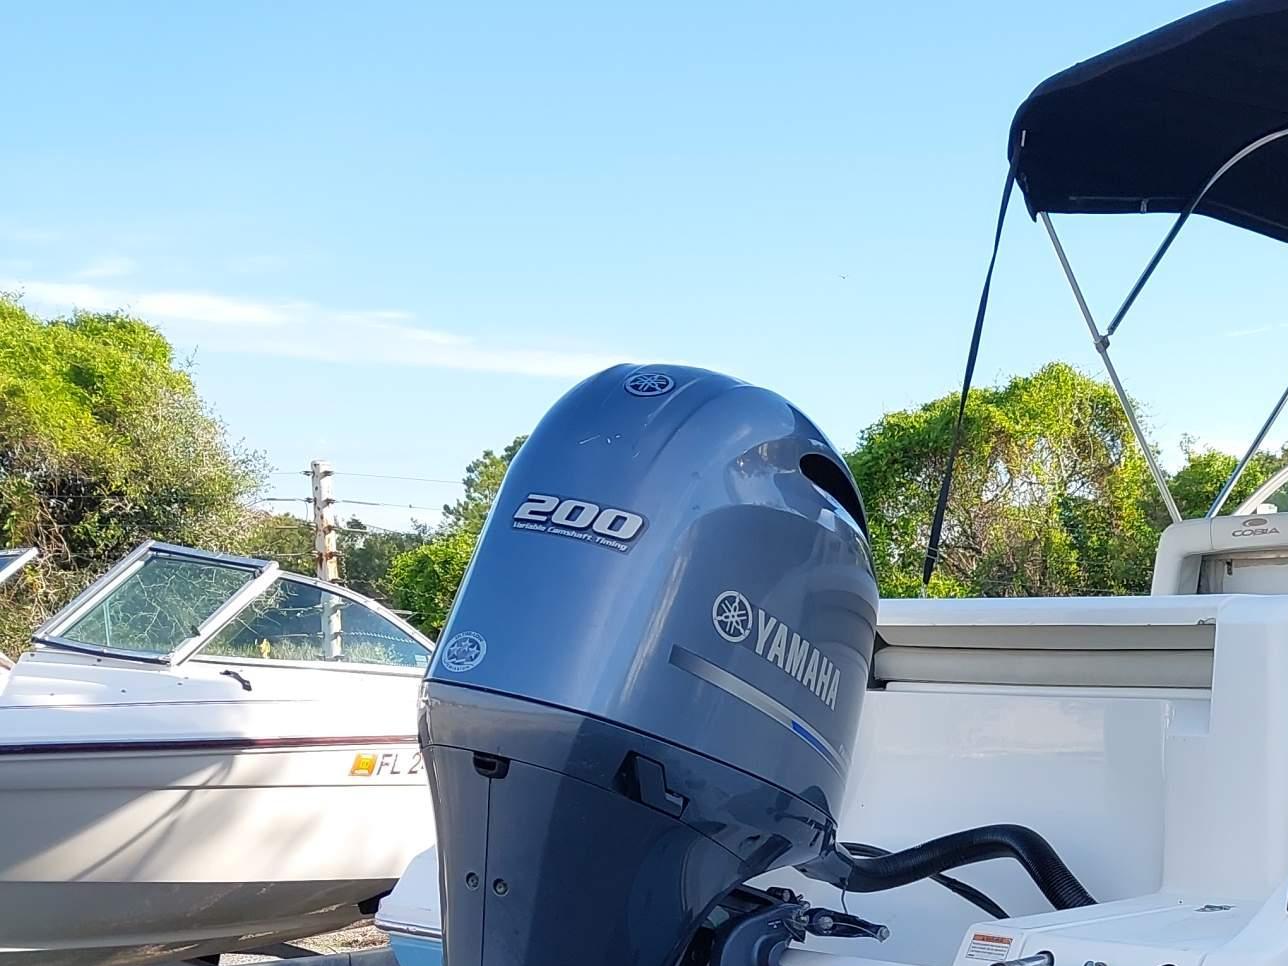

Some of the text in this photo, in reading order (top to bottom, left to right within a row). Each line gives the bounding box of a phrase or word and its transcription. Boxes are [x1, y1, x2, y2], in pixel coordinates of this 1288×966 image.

[512, 493, 645, 540] 200
[513, 522, 628, 552] Variable Camshaft Timing
[1232, 528, 1280, 537] COBIA
[755, 608, 841, 711] YAMAHA
[376, 751, 425, 776] FL 2
